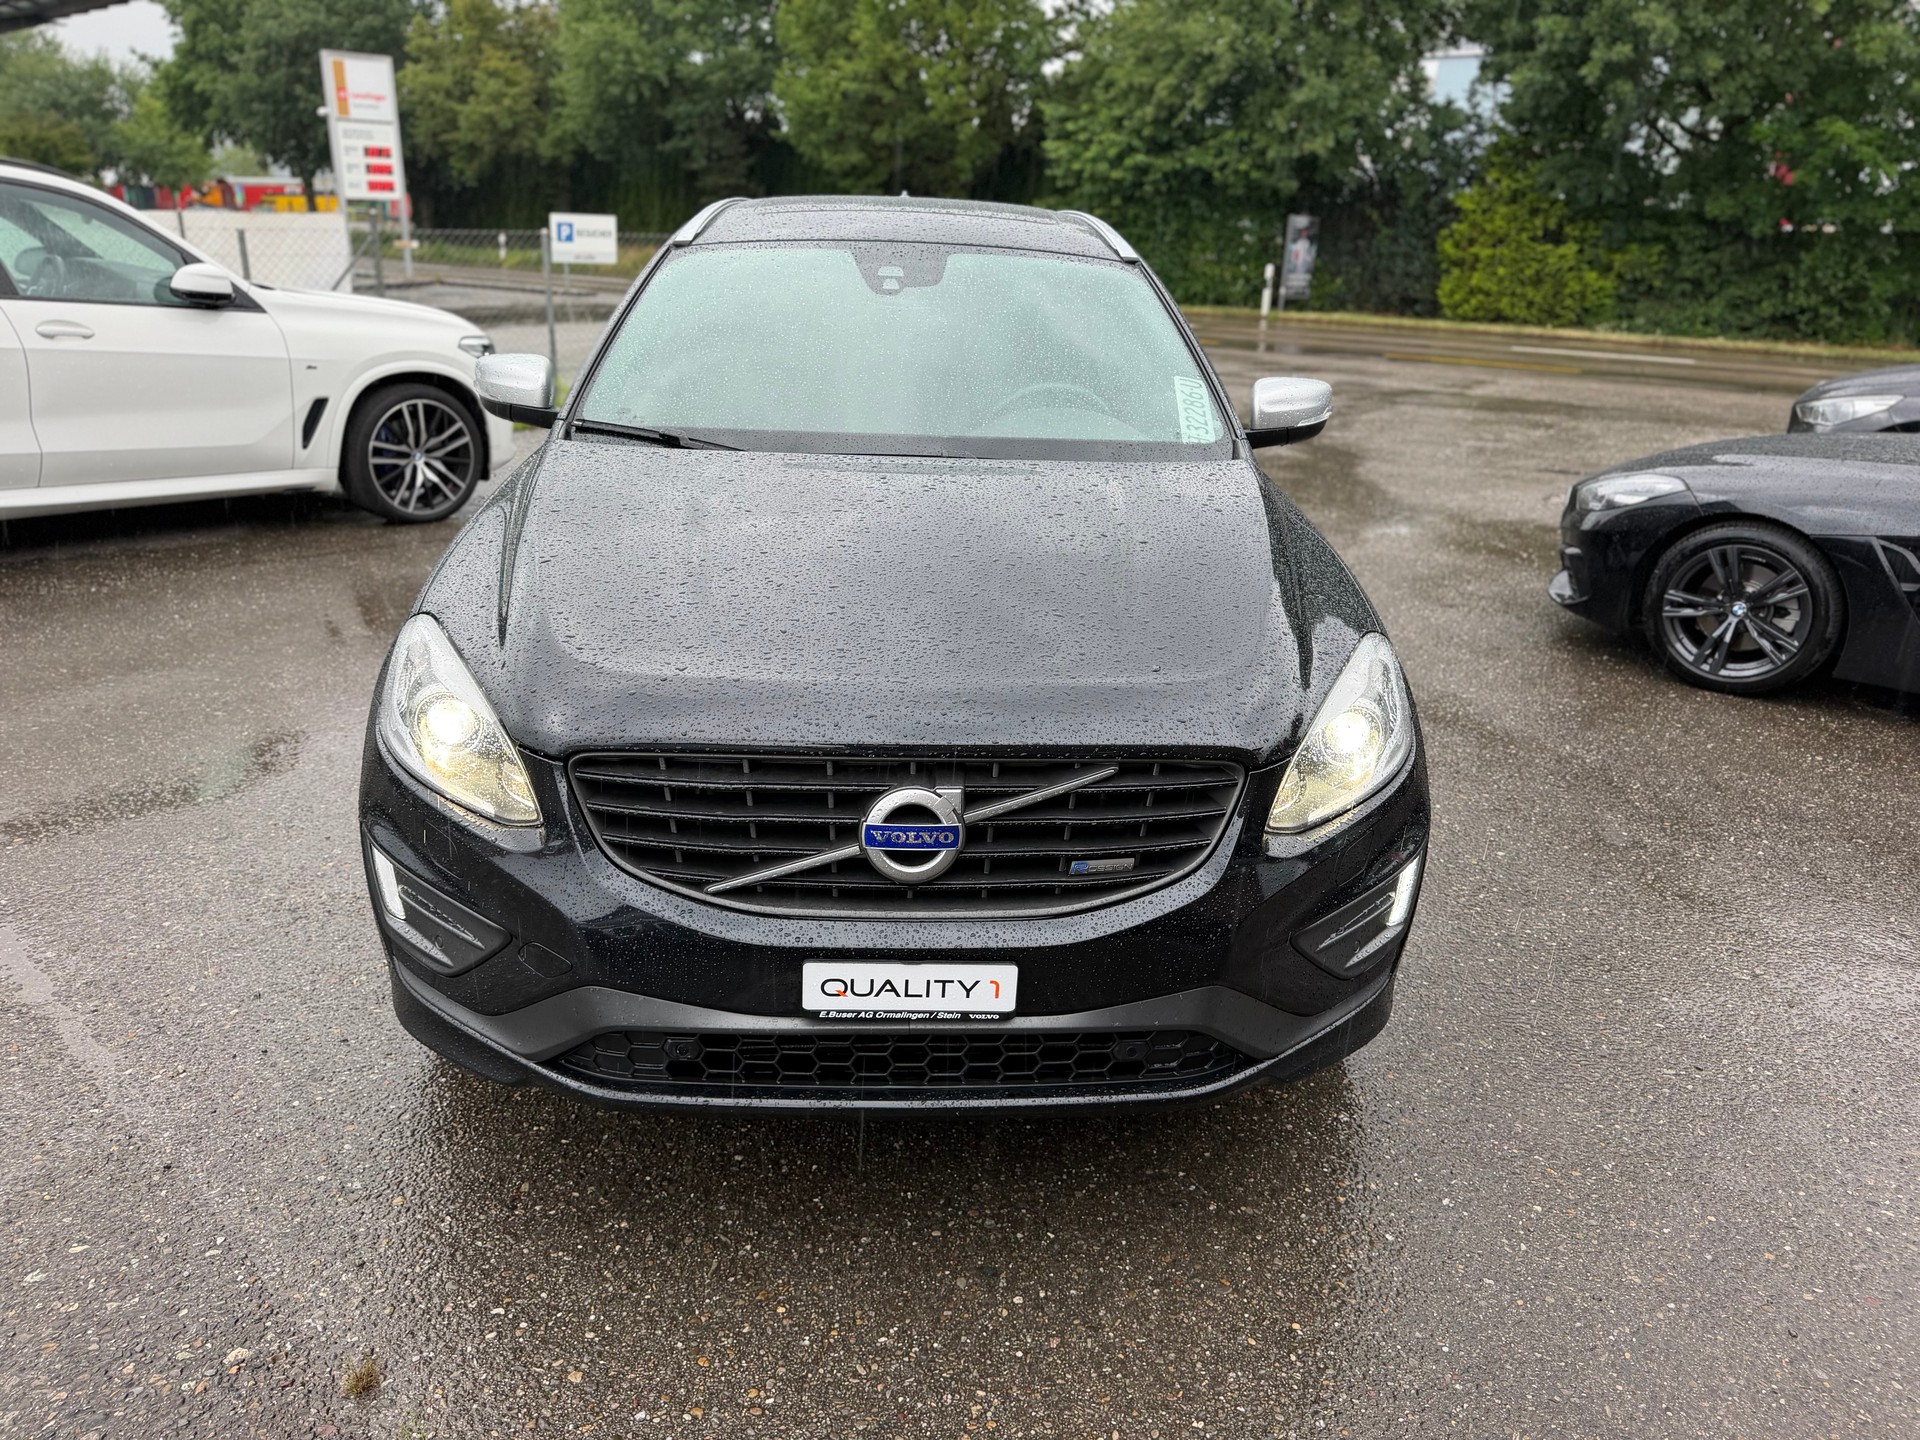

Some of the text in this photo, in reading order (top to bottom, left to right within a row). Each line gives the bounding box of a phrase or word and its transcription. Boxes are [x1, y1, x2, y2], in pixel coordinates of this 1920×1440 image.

[560, 223, 571, 241] P
[871, 830, 955, 844] VOLVO
[820, 978, 1000, 999] QUALITY 1
[819, 1011, 857, 1019] E.Buser
[858, 1011, 874, 1019] AG
[875, 1011, 929, 1020] Ormalingen
[937, 1011, 961, 1019] Stein
